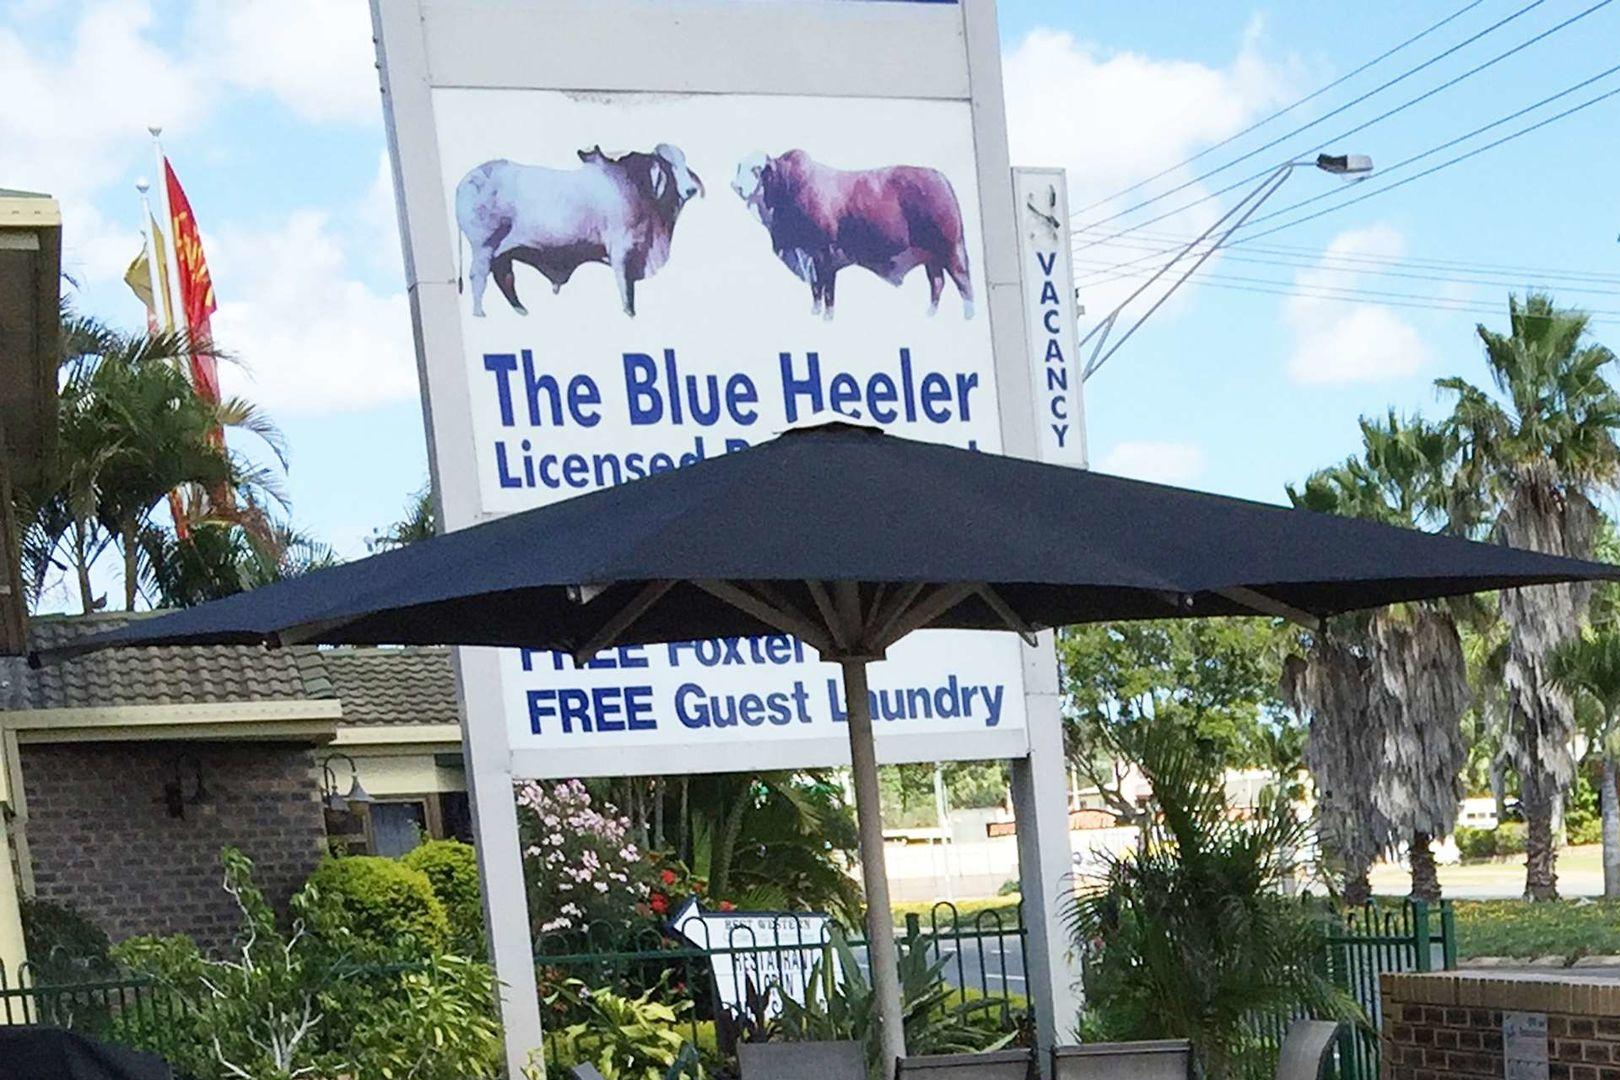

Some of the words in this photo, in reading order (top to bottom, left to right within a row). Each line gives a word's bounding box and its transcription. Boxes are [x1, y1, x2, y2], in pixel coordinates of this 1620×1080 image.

[483, 349, 601, 427] The
[622, 348, 759, 426] Blue
[779, 348, 978, 424] Heeler
[1036, 252, 1069, 448] VACANCY
[526, 686, 657, 735] FREE
[675, 681, 811, 729] Guest
